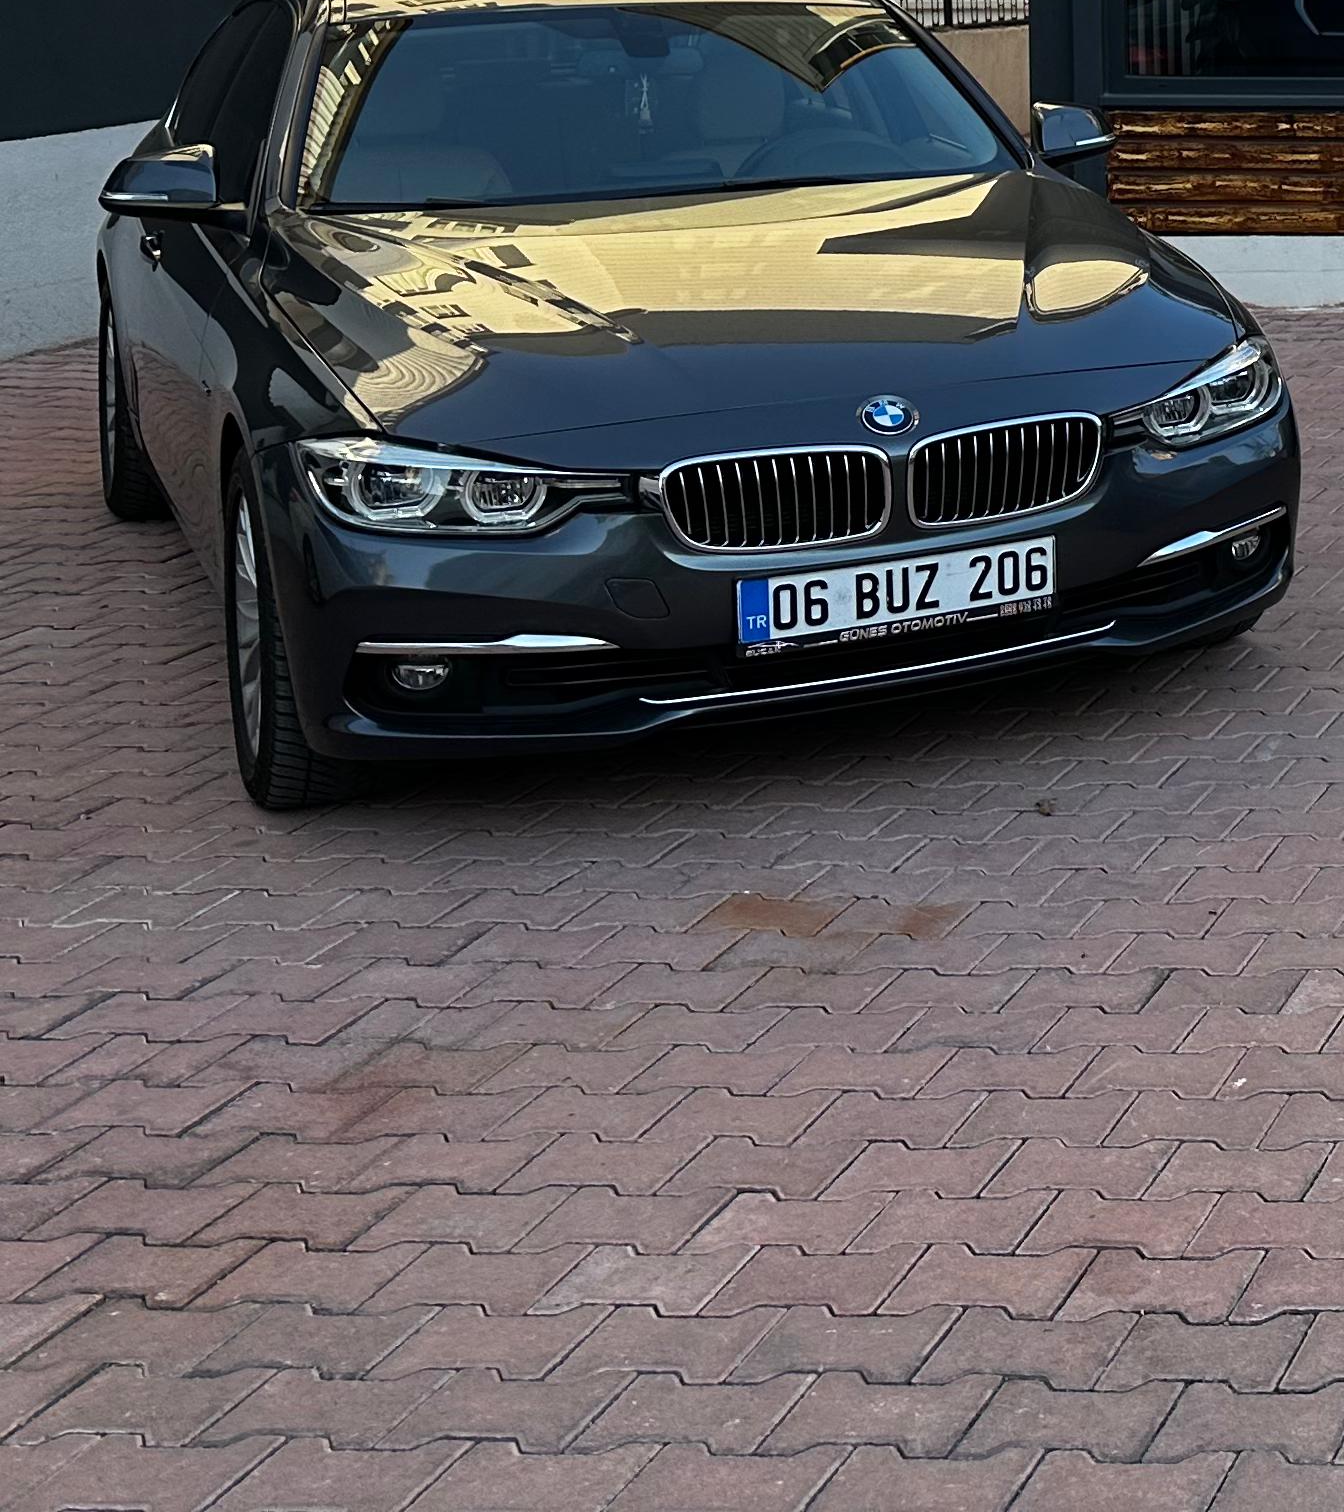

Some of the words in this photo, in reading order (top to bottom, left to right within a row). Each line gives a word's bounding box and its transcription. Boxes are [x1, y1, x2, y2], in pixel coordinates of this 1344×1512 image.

[746, 614, 767, 630] TR
[772, 579, 829, 630] 06
[855, 562, 940, 620] BUZ
[968, 546, 1048, 602] 206
